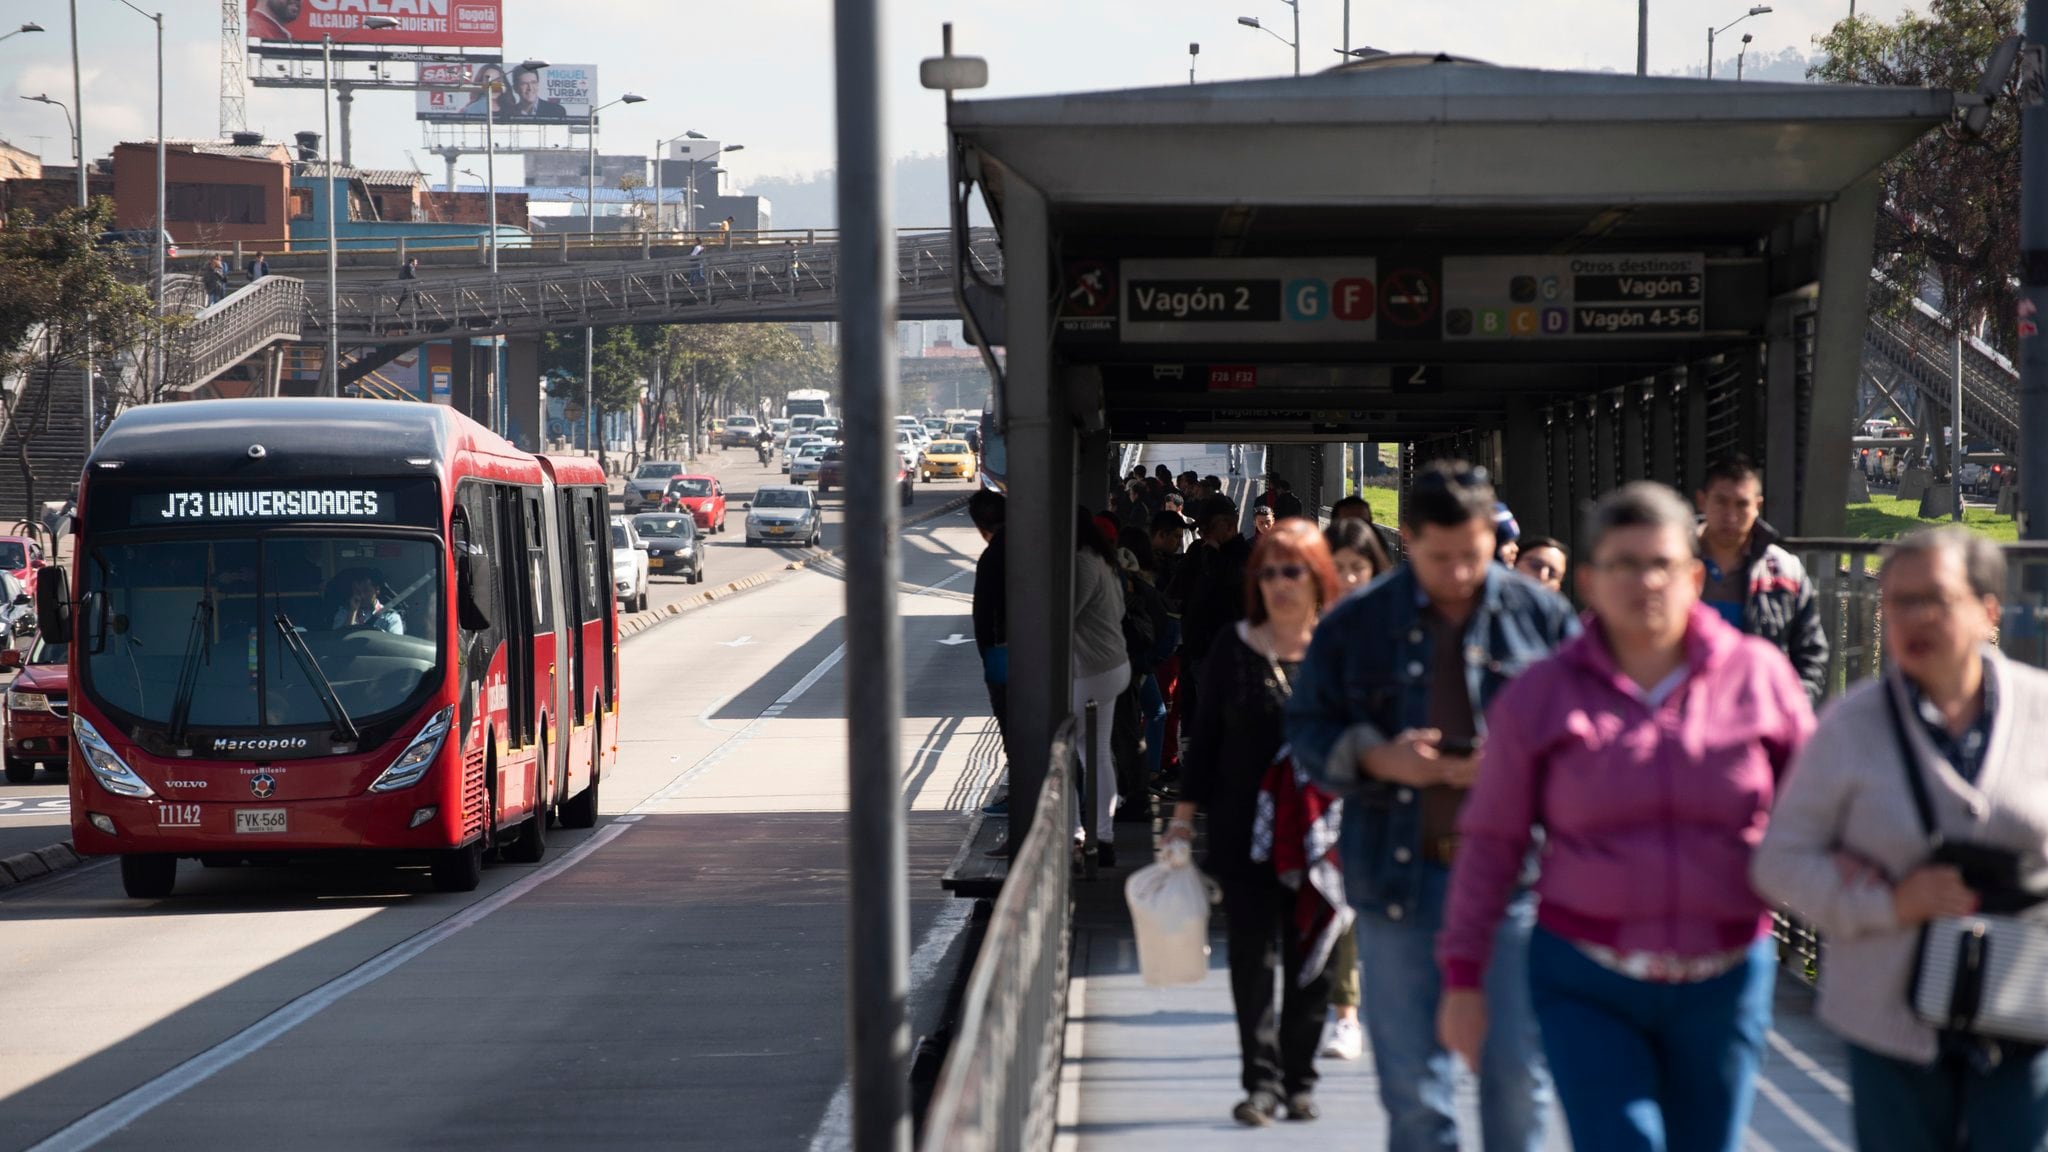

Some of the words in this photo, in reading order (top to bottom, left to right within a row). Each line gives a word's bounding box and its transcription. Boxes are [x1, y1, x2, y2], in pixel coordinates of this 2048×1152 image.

[309, 12, 359, 29] ALCALDE
[547, 69, 588, 80] MIGUEL
[547, 79, 577, 88] URIBE
[547, 88, 588, 97] TURBAY
[1571, 259, 1615, 274] Otros
[1620, 258, 1691, 273] destinos:
[1543, 278, 1558, 299] G
[1619, 276, 1683, 298] Vagón
[1689, 276, 1700, 293] 3
[1136, 286, 1225, 317] Vagón
[1234, 287, 1250, 311] 2
[1296, 285, 1318, 316] G
[1343, 285, 1361, 314] F
[1063, 321, 1079, 330] NO
[1484, 312, 1498, 331] B
[1516, 311, 1531, 330] C
[1549, 311, 1562, 330] D
[1581, 309, 1644, 331] Vagón
[1650, 308, 1699, 325] 4-5-6
[1235, 371, 1253, 382] F32
[1408, 364, 1428, 385] 2
[161, 492, 204, 518] J73
[209, 490, 379, 517] UNIVERSIDADES
[213, 737, 307, 751] Marcopolo
[240, 766, 287, 775] TransMilenio
[165, 780, 208, 788] VOLVO
[159, 804, 201, 824] T1142
[237, 812, 286, 828] FVK-568
